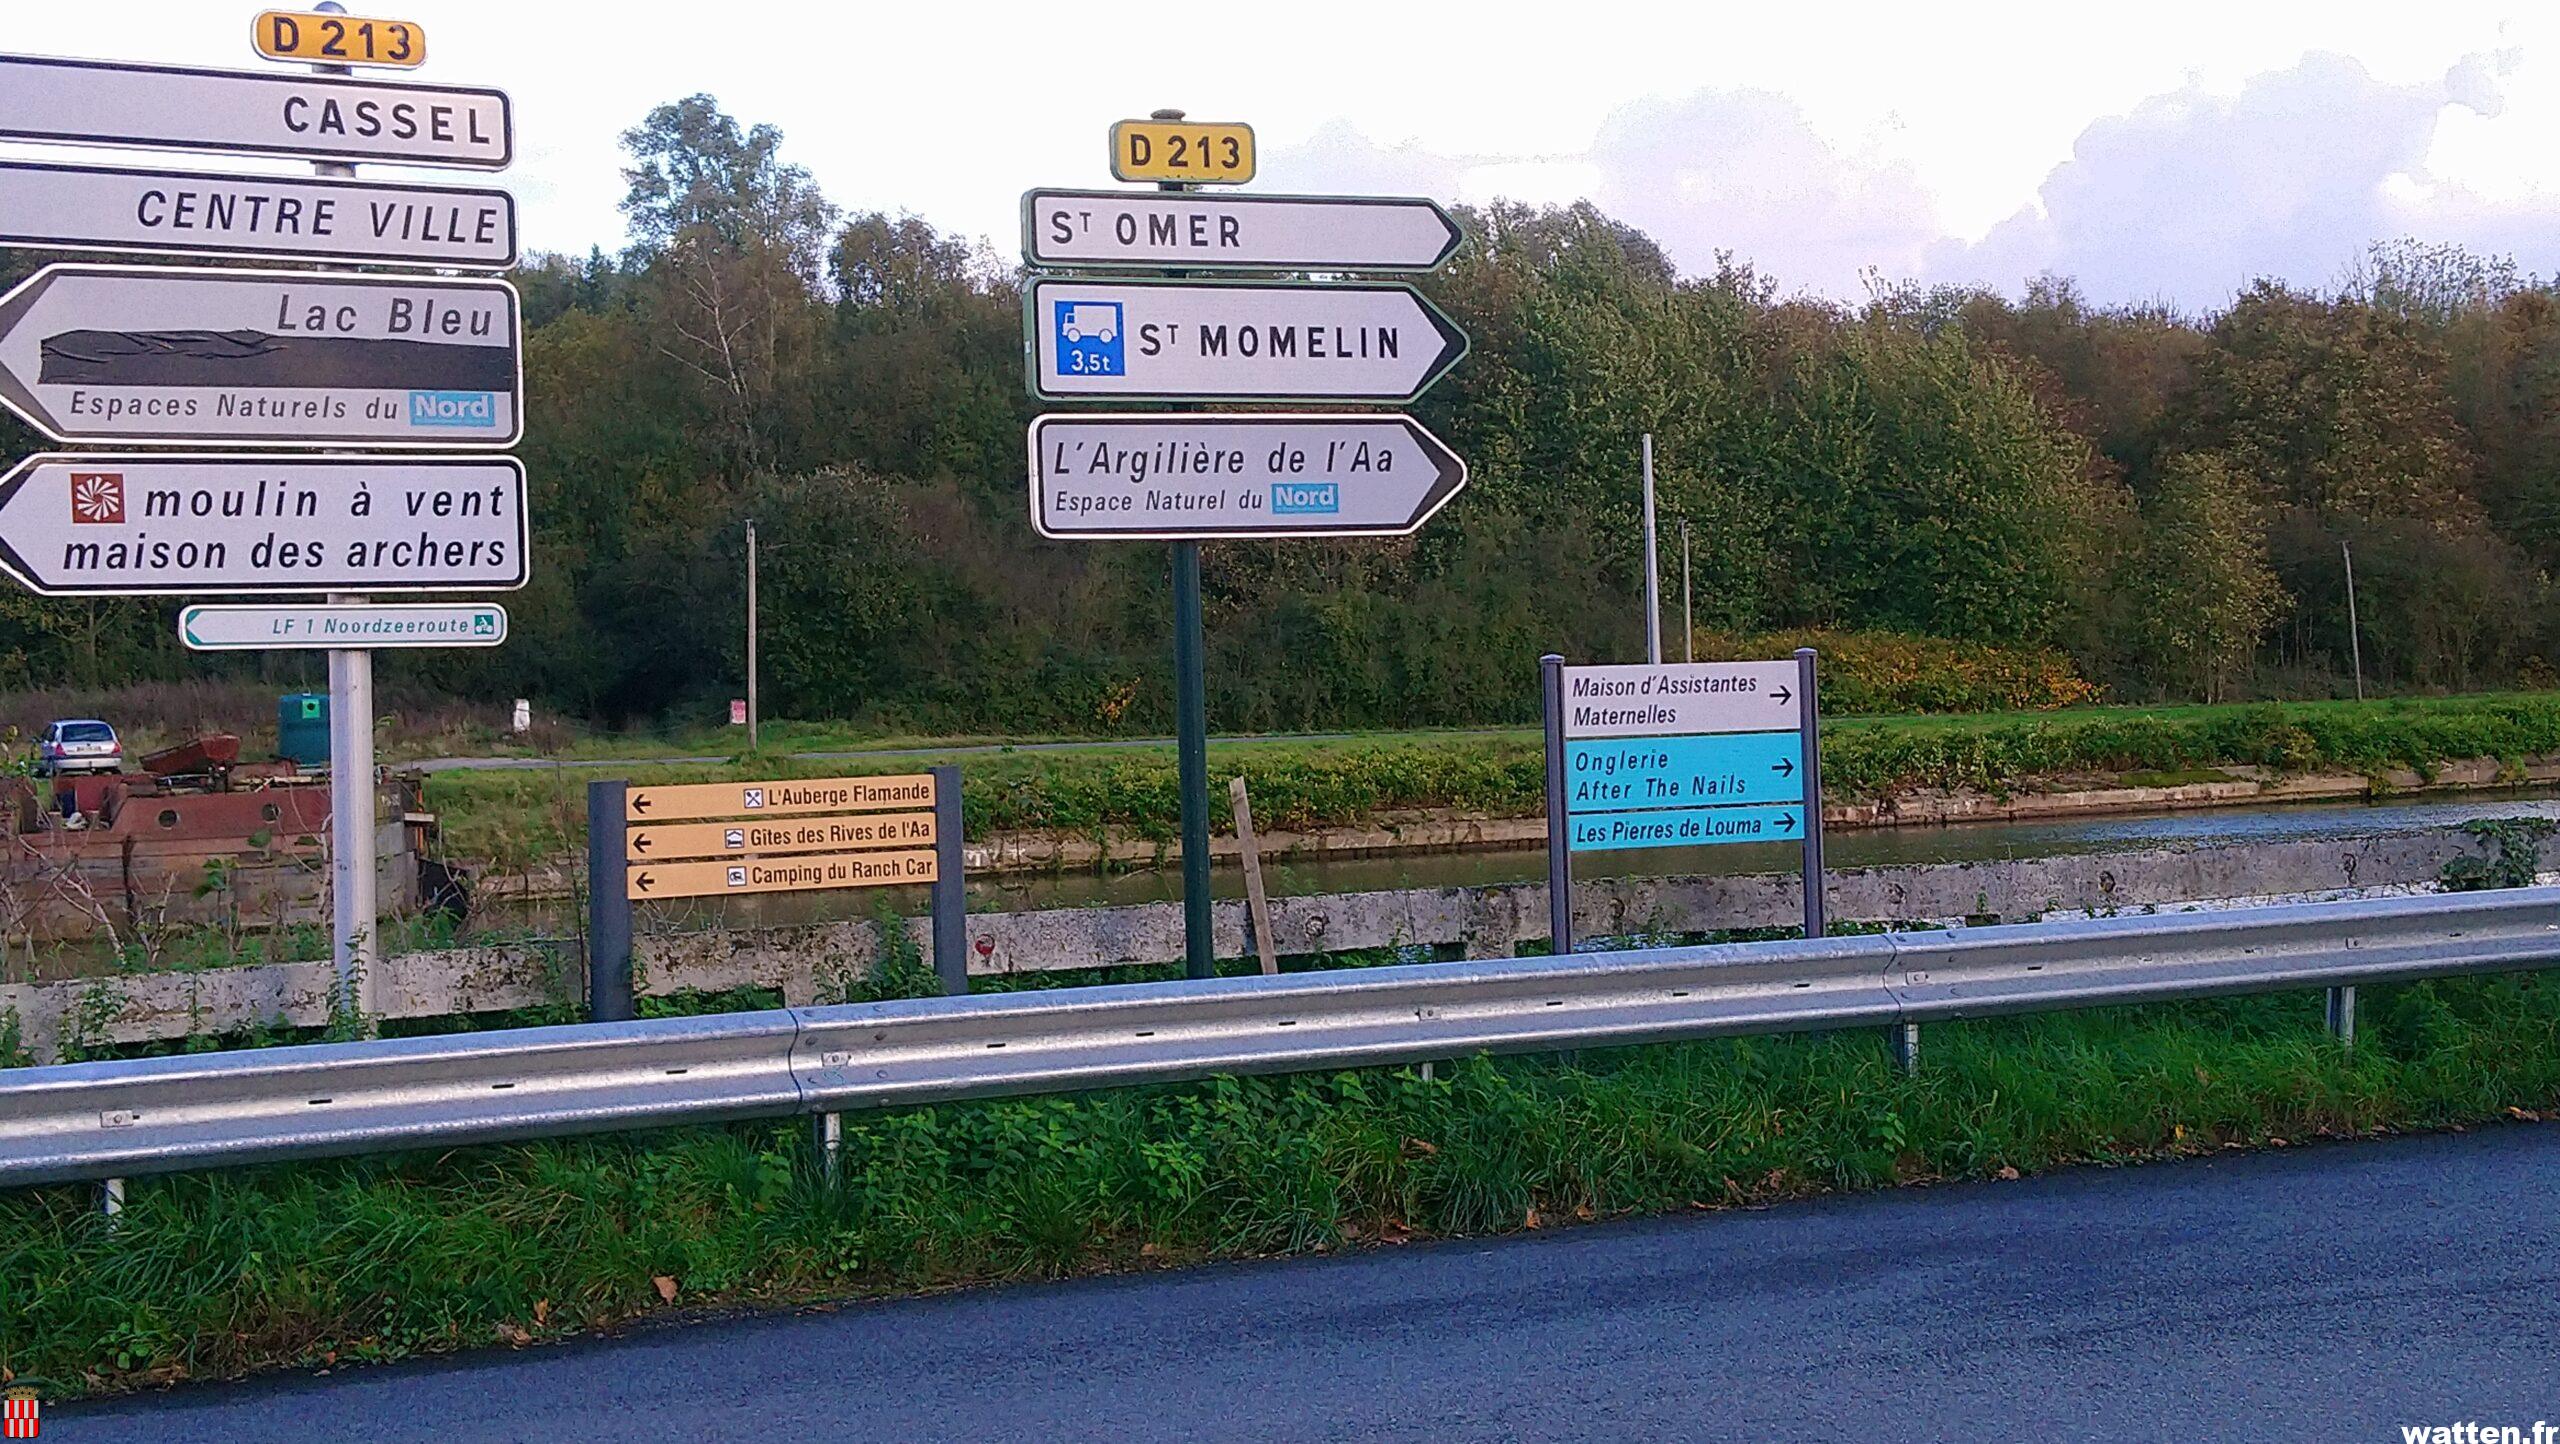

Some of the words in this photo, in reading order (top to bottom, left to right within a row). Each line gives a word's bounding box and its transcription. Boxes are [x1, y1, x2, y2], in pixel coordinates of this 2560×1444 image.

[273, 16, 299, 53] D
[321, 22, 411, 61] 213
[283, 96, 490, 144] CASSEL
[1131, 134, 1151, 166] D
[1168, 135, 1240, 168] 213
[138, 190, 335, 236] CENTRE
[370, 202, 498, 244] VILLE
[1116, 213, 1240, 247] OMER
[278, 294, 358, 332] Lac
[389, 298, 492, 336] Bleu
[1201, 325, 1398, 358] MOMELIN
[1070, 351, 1111, 374] 3,5t
[70, 391, 198, 420] Espaces
[217, 394, 347, 419] Naturels
[366, 400, 398, 420] du
[415, 394, 488, 419] Nord
[1054, 442, 1244, 483] L'Argilière
[1268, 443, 1305, 473] de
[1327, 441, 1393, 473] l'Aa
[145, 481, 317, 517] moulin
[351, 482, 372, 517] à
[406, 485, 504, 516] vent
[1056, 490, 1132, 515] Espace
[1146, 490, 1226, 510] Naturel
[1239, 489, 1262, 509] du
[1276, 486, 1335, 506] Nord
[63, 534, 226, 570] maison
[251, 533, 324, 568] des
[346, 534, 505, 568] archers
[273, 618, 295, 634] LF
[306, 618, 314, 634] 1
[324, 617, 469, 634] Noordzeeroute
[1573, 677, 1635, 697] Maison
[1640, 674, 1757, 695] d'Assistantes
[1574, 705, 1676, 726] Maternelles
[1576, 751, 1668, 775] Onglerie
[769, 789, 848, 807] L'Auberge
[854, 783, 929, 800] Flamande
[1576, 780, 1631, 800] After
[1646, 778, 1679, 798] The
[1692, 775, 1746, 796] Nails
[797, 827, 824, 843] des
[831, 823, 874, 842] Rives
[879, 823, 897, 839] de
[902, 821, 930, 837] l'Aa
[1577, 823, 1605, 843] Les
[1611, 820, 1673, 841] Pierres
[1679, 817, 1699, 836] de
[1705, 817, 1761, 837] Louma
[752, 863, 822, 886] Camping
[829, 864, 846, 880] du
[853, 859, 900, 878] Ranch
[907, 858, 932, 875] Car
